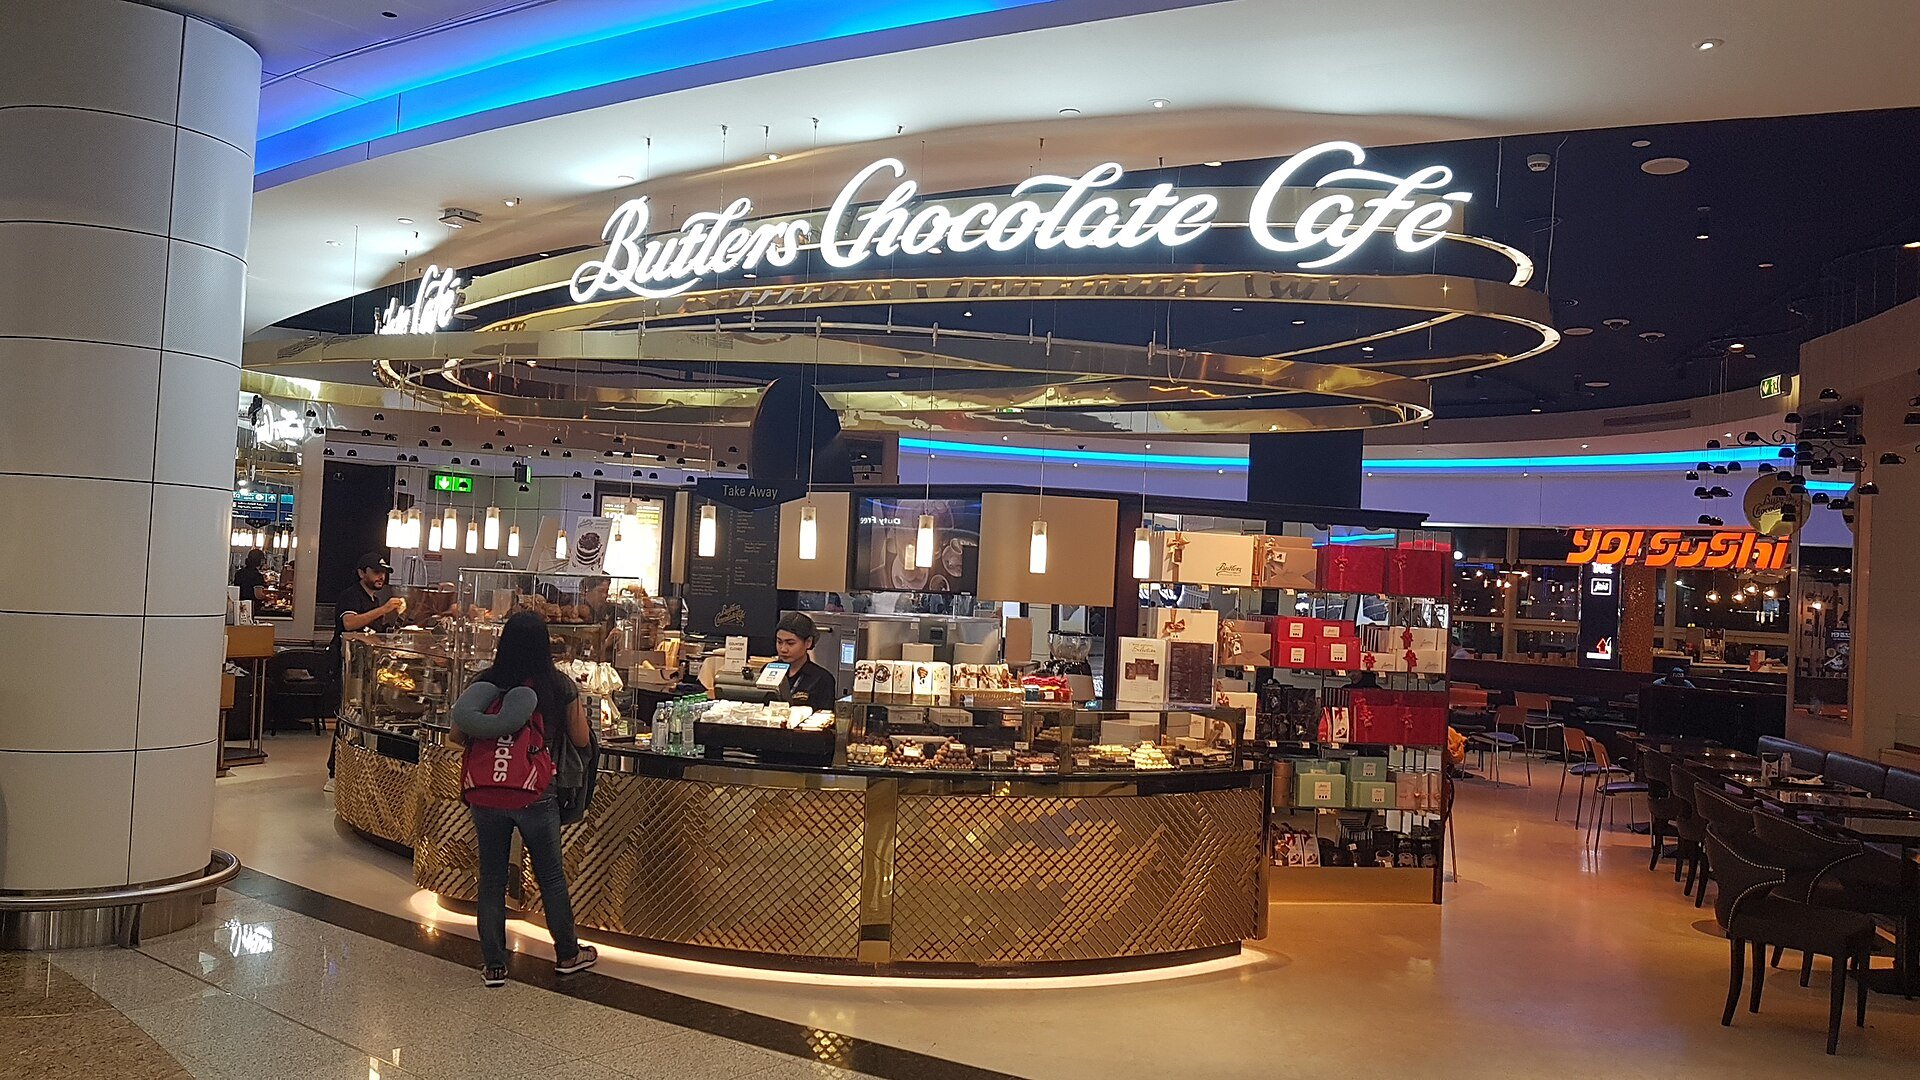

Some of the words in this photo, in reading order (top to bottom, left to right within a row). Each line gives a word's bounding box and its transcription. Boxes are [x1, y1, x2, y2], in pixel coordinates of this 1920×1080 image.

[569, 195, 810, 303] Butlers
[820, 157, 1219, 268] Chocolate
[1248, 140, 1474, 269] Café
[722, 484, 746, 497] Take
[748, 485, 778, 500] Away
[493, 734, 514, 782] didas
